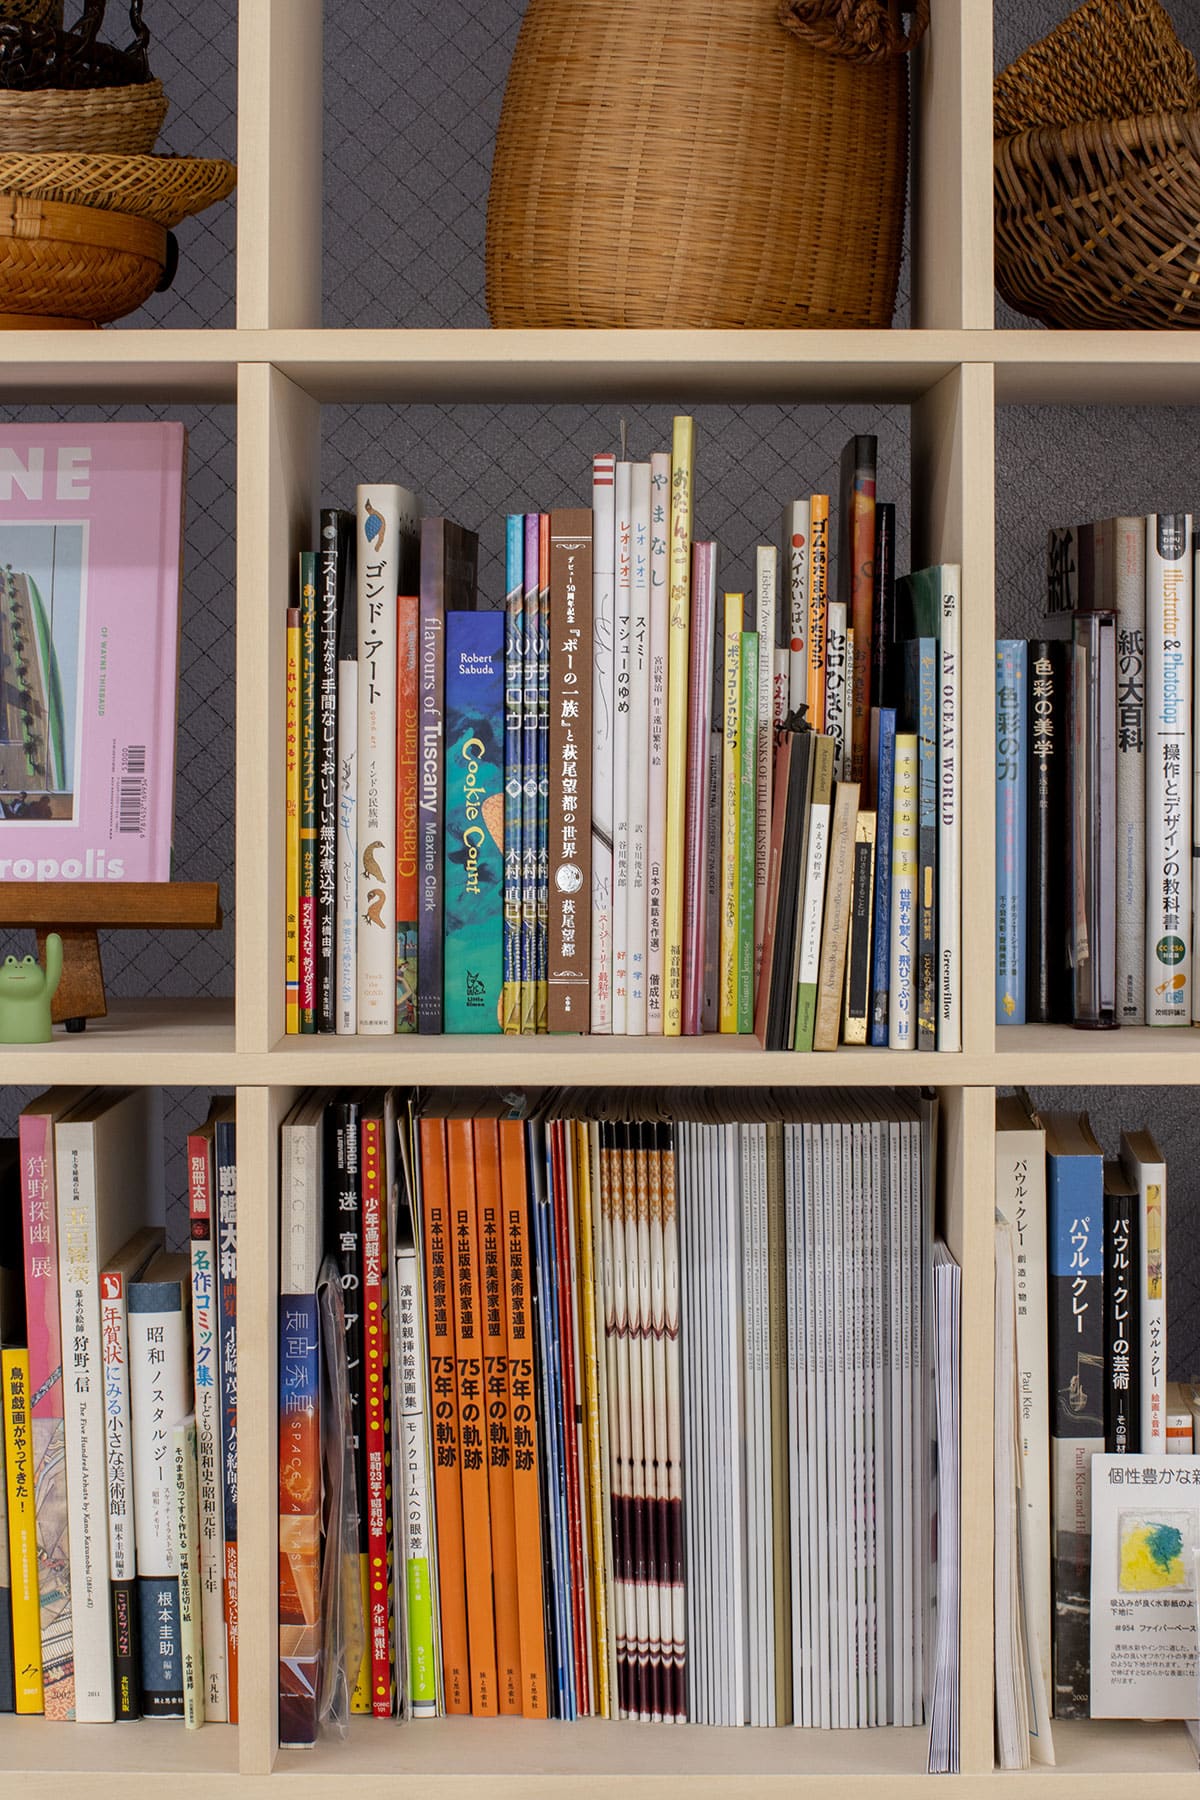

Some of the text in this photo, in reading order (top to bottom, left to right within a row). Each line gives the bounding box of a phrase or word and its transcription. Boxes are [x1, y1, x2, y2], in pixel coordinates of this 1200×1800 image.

[458, 664, 495, 675] Sabuda
[460, 652, 493, 664] Robert
[1117, 629, 1144, 754] 紙の大百科
[420, 721, 442, 813] Tuscany
[191, 1156, 207, 1213] 別冊太陽
[431, 1207, 447, 1337] 日本出版美術家連盟
[457, 1210, 474, 1339] 日本出版美術家連盟
[484, 1207, 501, 1337] 日本出版美術家連盟
[509, 1210, 525, 1340] 日本出版美術家連盟
[1068, 1216, 1090, 1334] パウル・クレー
[1112, 1219, 1130, 1391] パウル・クレーの芸術
[146, 1326, 167, 1481] 昭和ノスタルジー
